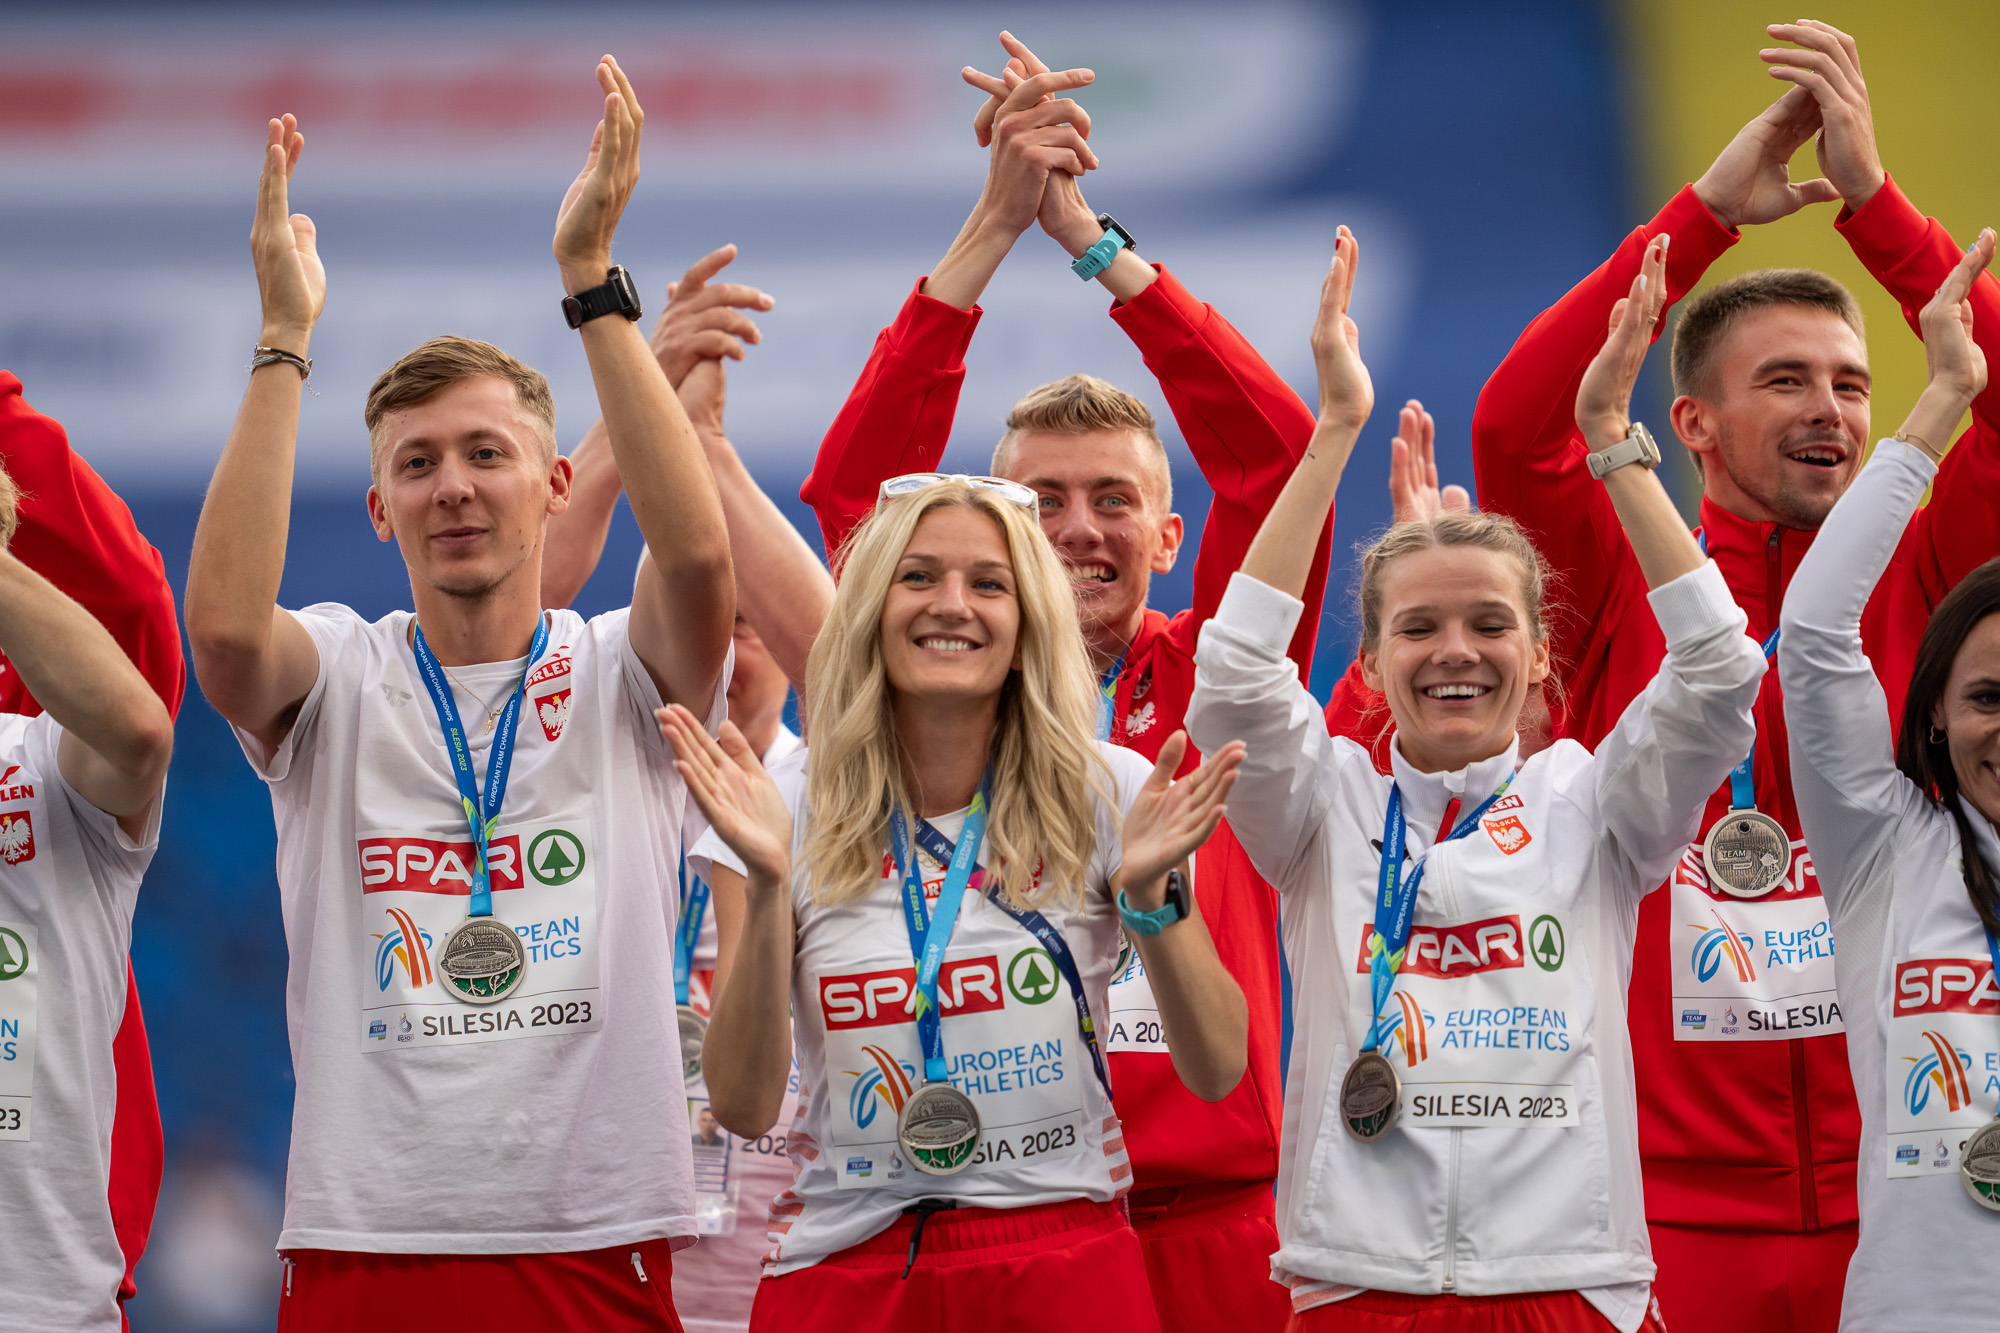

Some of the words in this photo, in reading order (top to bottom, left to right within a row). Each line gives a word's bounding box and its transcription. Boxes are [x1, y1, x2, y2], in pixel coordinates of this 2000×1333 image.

[425, 662, 437, 678] TEAM
[431, 678, 454, 722] CHAMPIONSHIPS
[450, 727, 463, 753] SILESIA
[457, 753, 468, 771] 2023
[488, 769, 501, 808] EUROPEAN
[495, 750, 505, 771] TEAM
[500, 699, 516, 751] CHAMPIONSHIPS
[1487, 796, 1520, 812] LEN
[1485, 818, 1517, 828] POLSKA
[361, 844, 518, 886] SPAR
[1722, 850, 1746, 858] TEAM
[1393, 901, 1409, 940] EUROPEAN
[1404, 881, 1414, 902] TEAM
[1765, 918, 1833, 947] EURO
[1899, 966, 2000, 1009] SPA
[422, 1010, 525, 1037] SILESIA
[530, 1001, 592, 1028] 2023
[1444, 1006, 1567, 1029] EUROPEAN
[1748, 1002, 1843, 1031] SILESIA
[947, 1039, 1062, 1075] UROPEAN
[1440, 1029, 1570, 1052] ATHLETICS
[951, 1062, 1064, 1096] THLETICS
[1413, 1095, 1511, 1118] SILESIA
[1519, 1096, 1568, 1118] 2023
[1021, 1124, 1076, 1158] 2023
